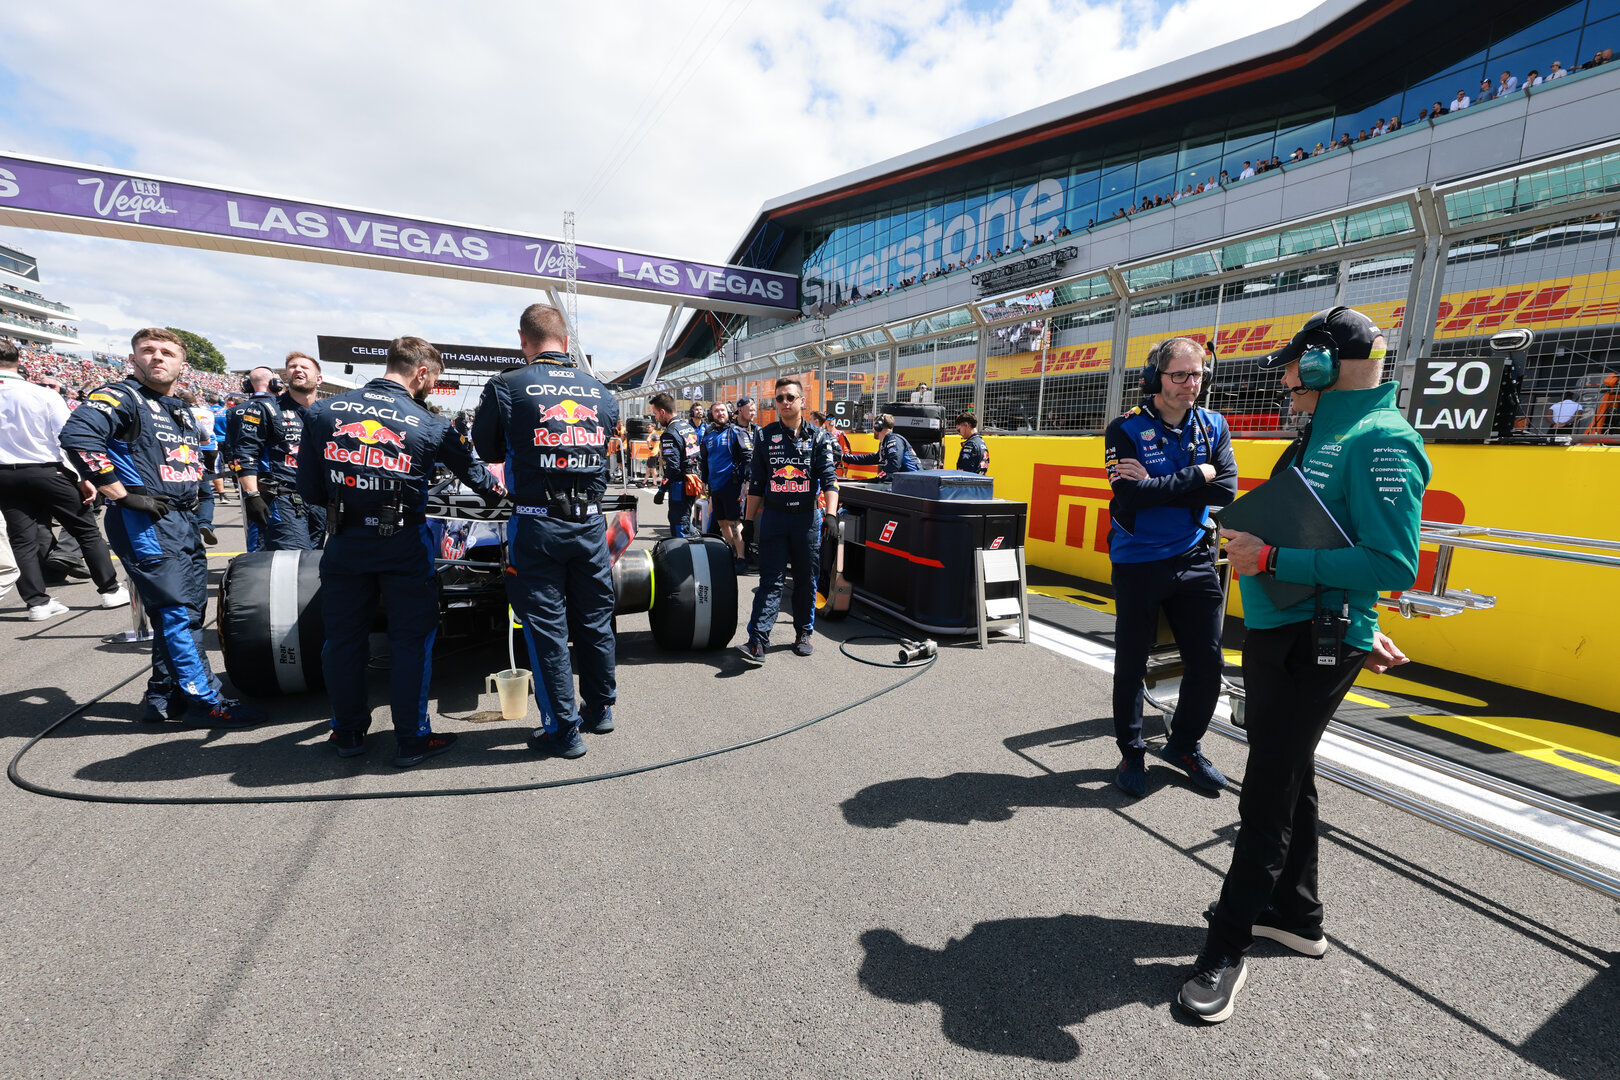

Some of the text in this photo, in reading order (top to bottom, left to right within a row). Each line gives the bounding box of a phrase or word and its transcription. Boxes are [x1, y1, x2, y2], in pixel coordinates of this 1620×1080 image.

[135, 180, 158, 194] LAS
[78, 178, 178, 222] Vegas
[227, 200, 490, 261] LAS VEGAS
[617, 257, 784, 300] LAS VEGAS
[459, 353, 488, 362] ASIAN
[1032, 347, 1102, 374] DHL
[1423, 361, 1491, 395] 30
[525, 384, 602, 398] ORACLE
[330, 401, 420, 427] ORACLE
[834, 402, 846, 414] 6
[1414, 408, 1488, 429] LAW
[533, 426, 573, 446] Red
[324, 441, 368, 465] Red
[366, 446, 412, 473] Bull
[540, 453, 586, 468] Mobil
[769, 457, 811, 466] ORACLE
[330, 469, 380, 490] Mobil
[770, 480, 810, 492] Red Bull
[516, 505, 550, 515] sparco
[279, 643, 288, 664] Rear
[287, 647, 296, 664] Left
